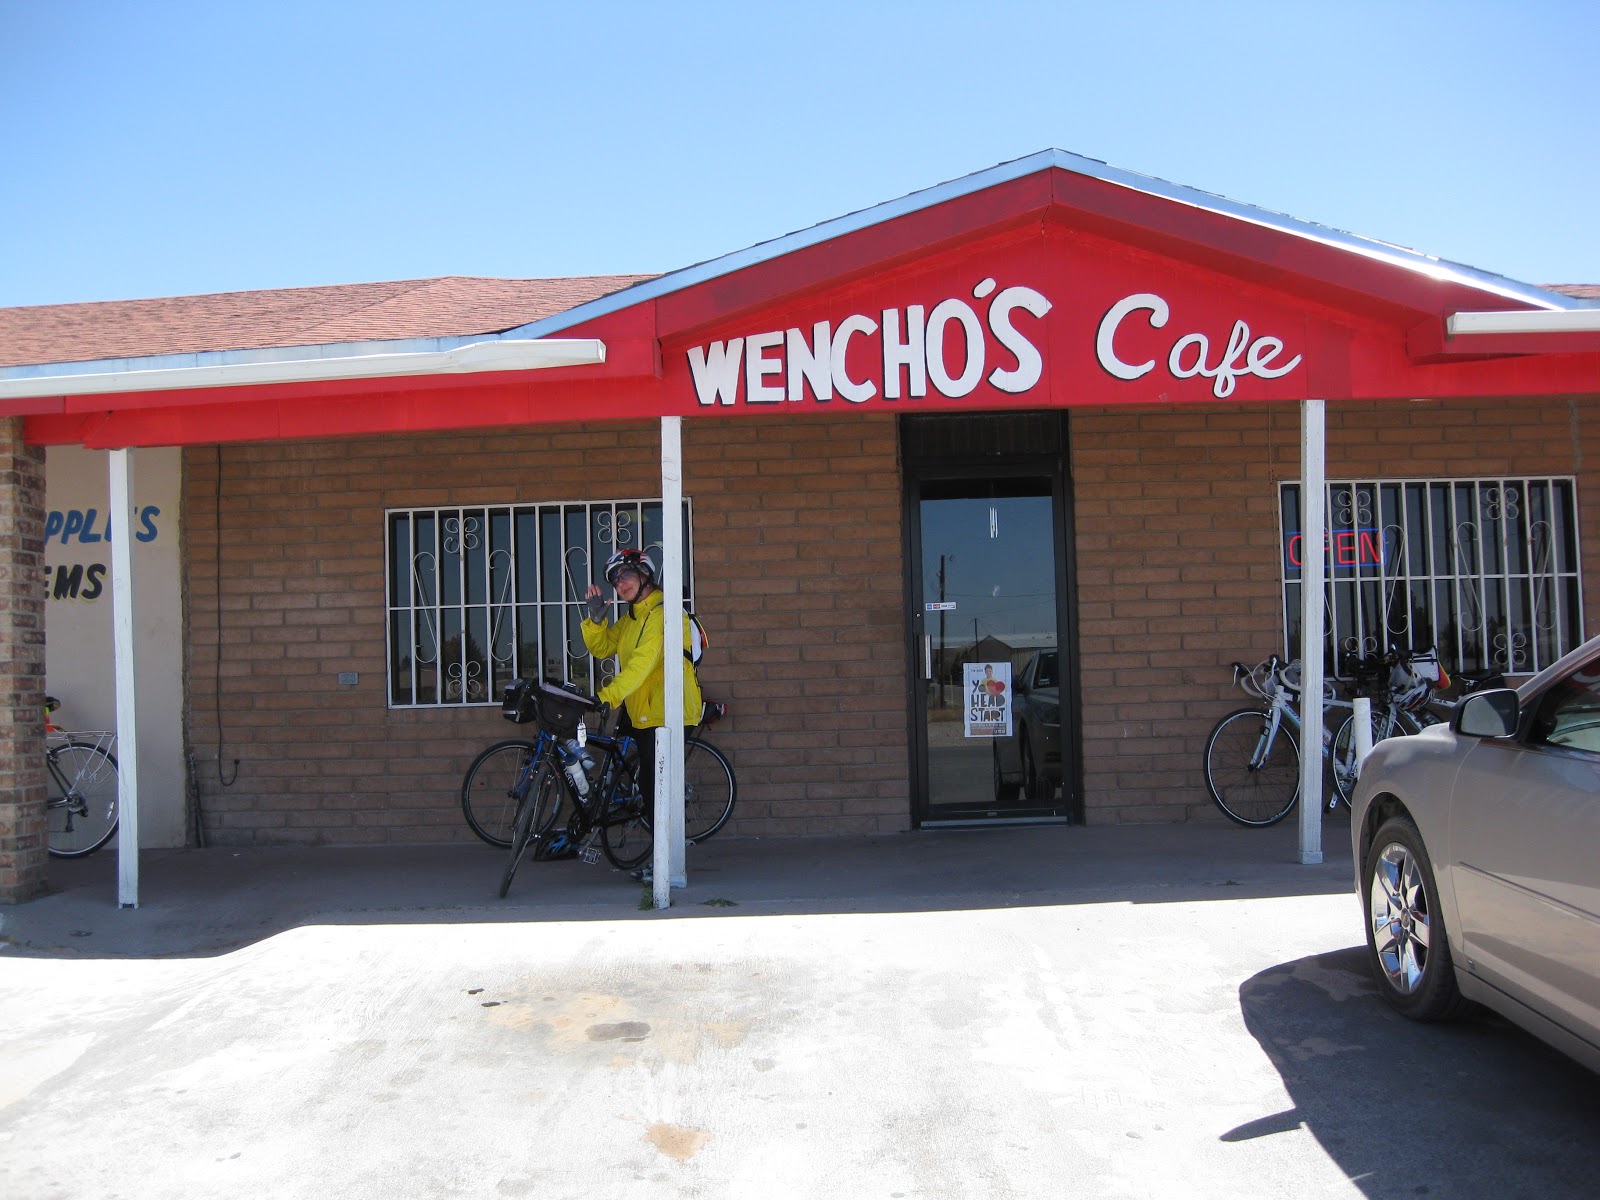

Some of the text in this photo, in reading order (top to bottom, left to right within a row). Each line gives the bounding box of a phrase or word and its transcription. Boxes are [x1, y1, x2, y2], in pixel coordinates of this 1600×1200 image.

[687, 277, 1302, 406] WENCHO'S Cafe
[1288, 532, 1381, 566] OEN
[970, 693, 1006, 707] HEAD
[970, 707, 1005, 722] START
